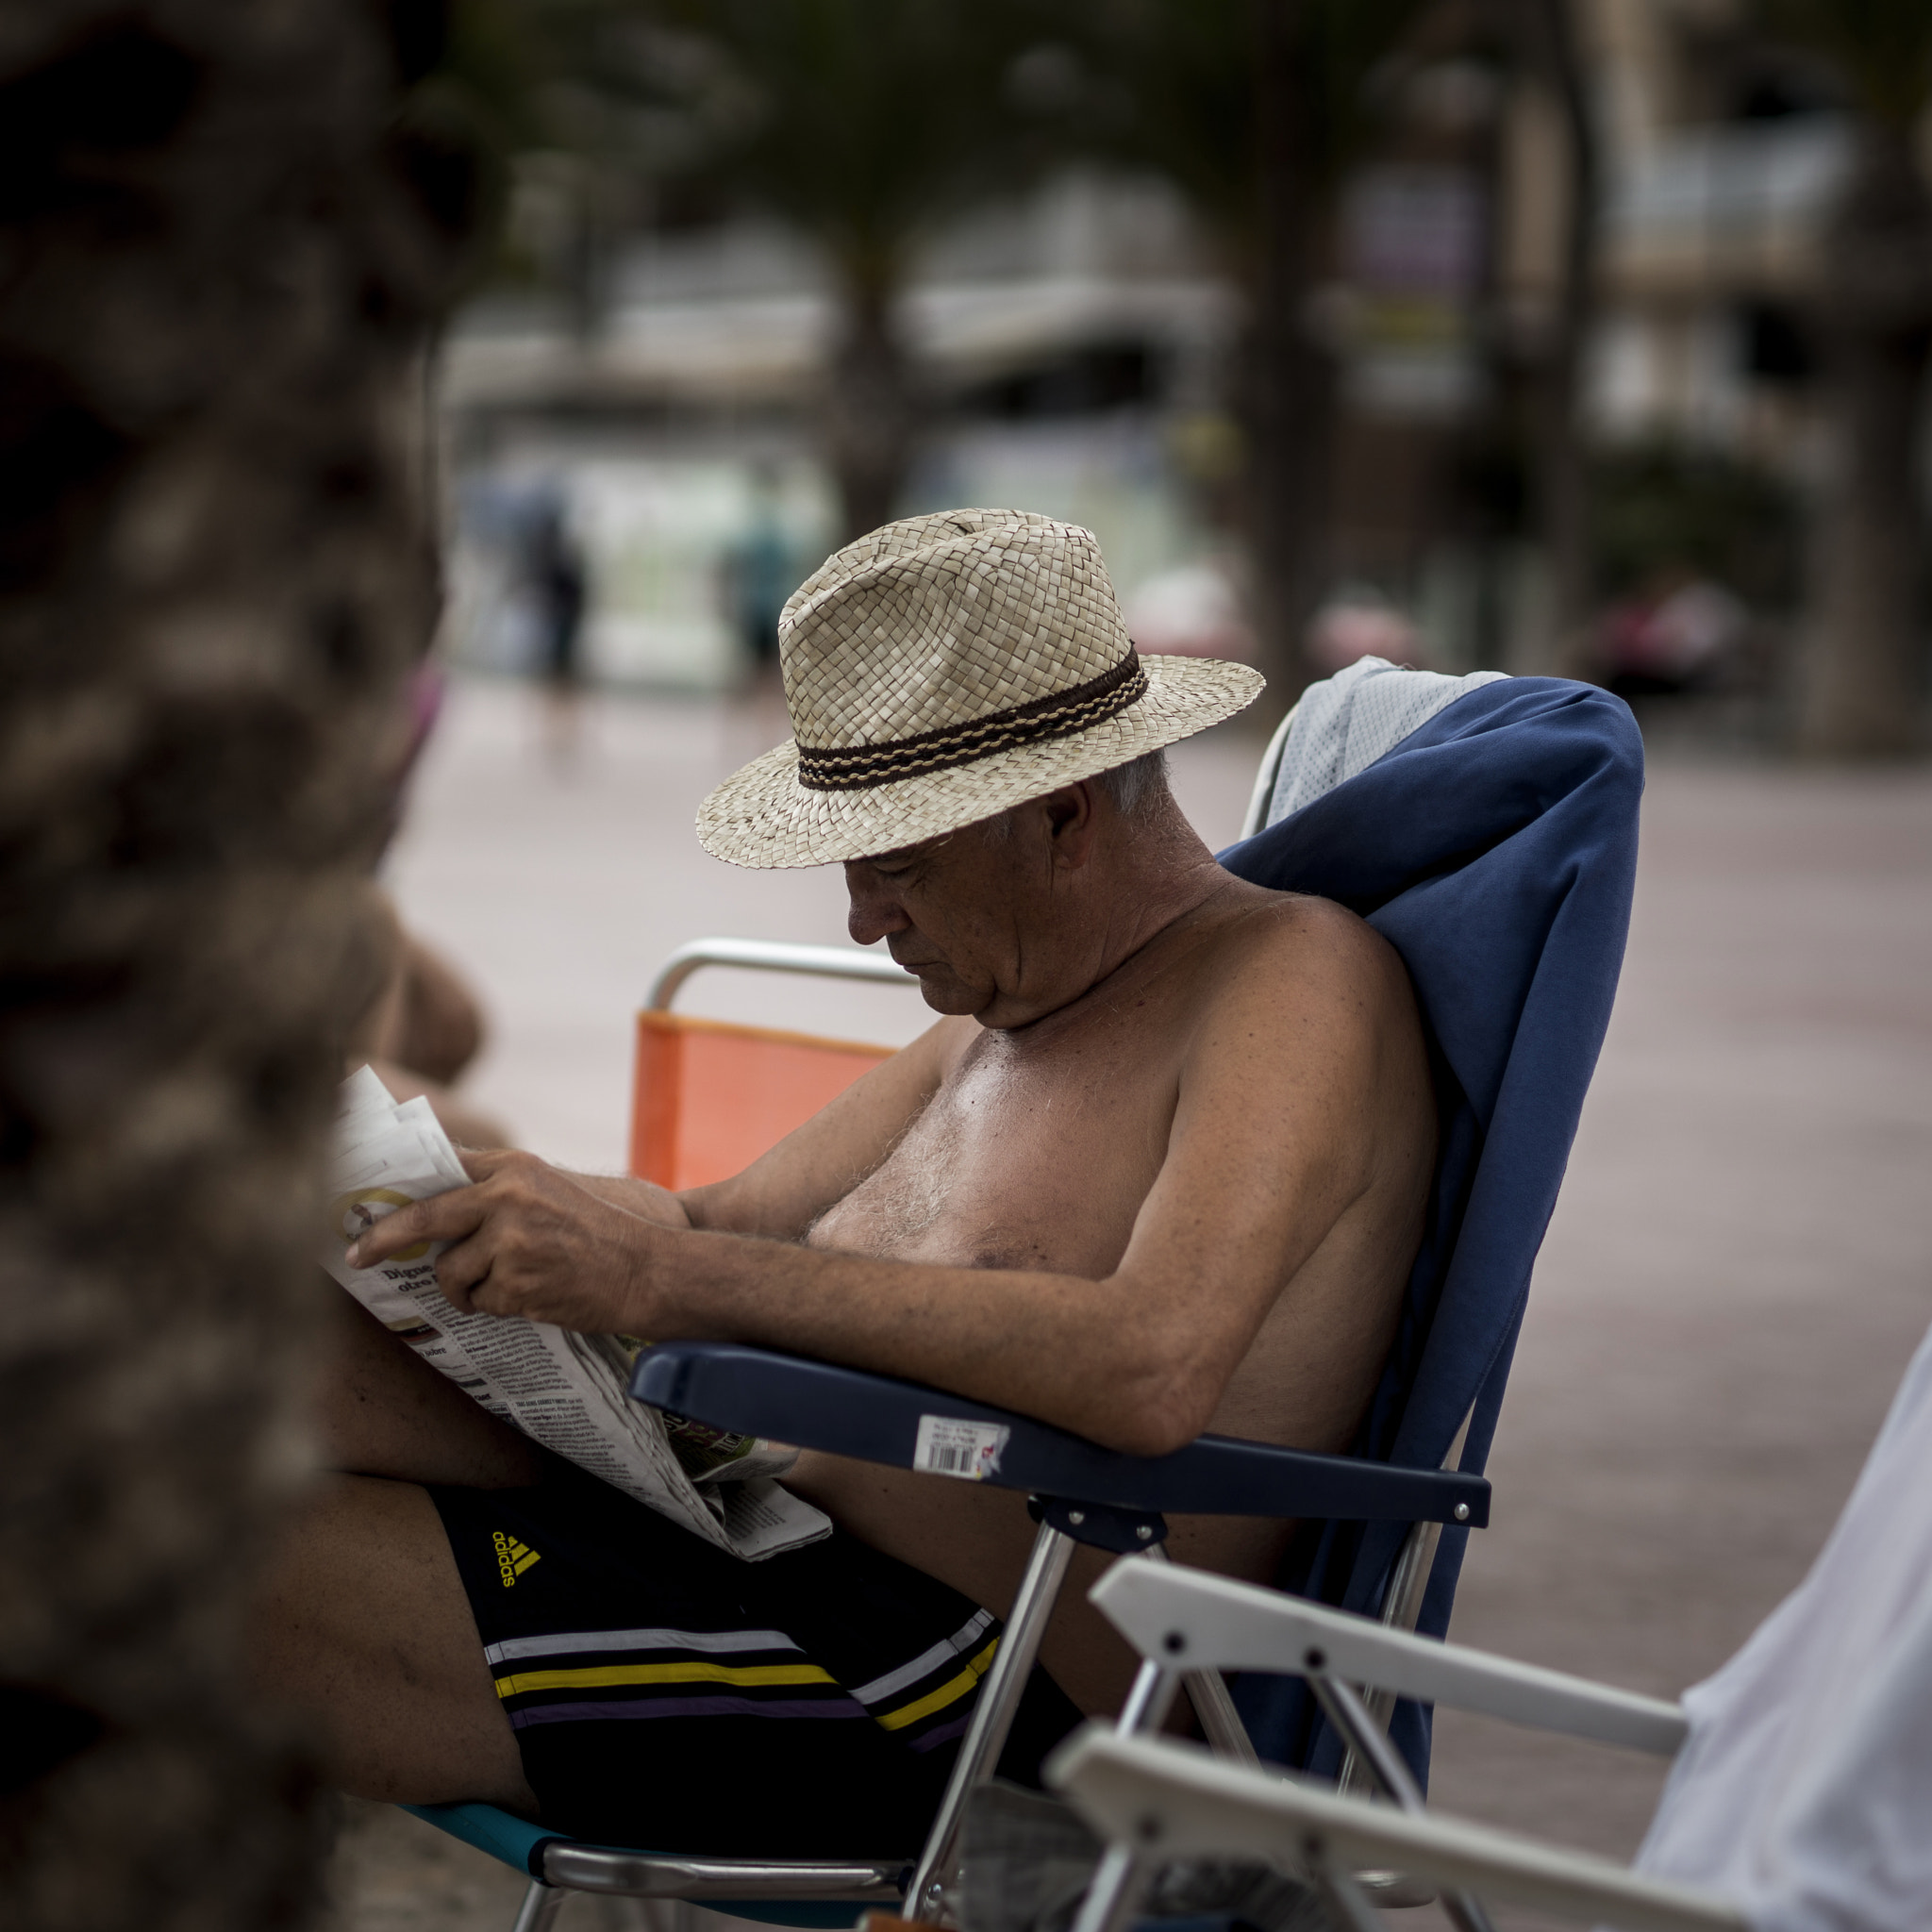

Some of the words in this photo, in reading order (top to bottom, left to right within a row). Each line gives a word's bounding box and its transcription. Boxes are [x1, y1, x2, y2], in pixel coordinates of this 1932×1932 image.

[381, 1265, 433, 1280] Digne
[398, 1279, 432, 1292] otro
[425, 1347, 447, 1357] sobre
[492, 1531, 515, 1588] adidas
